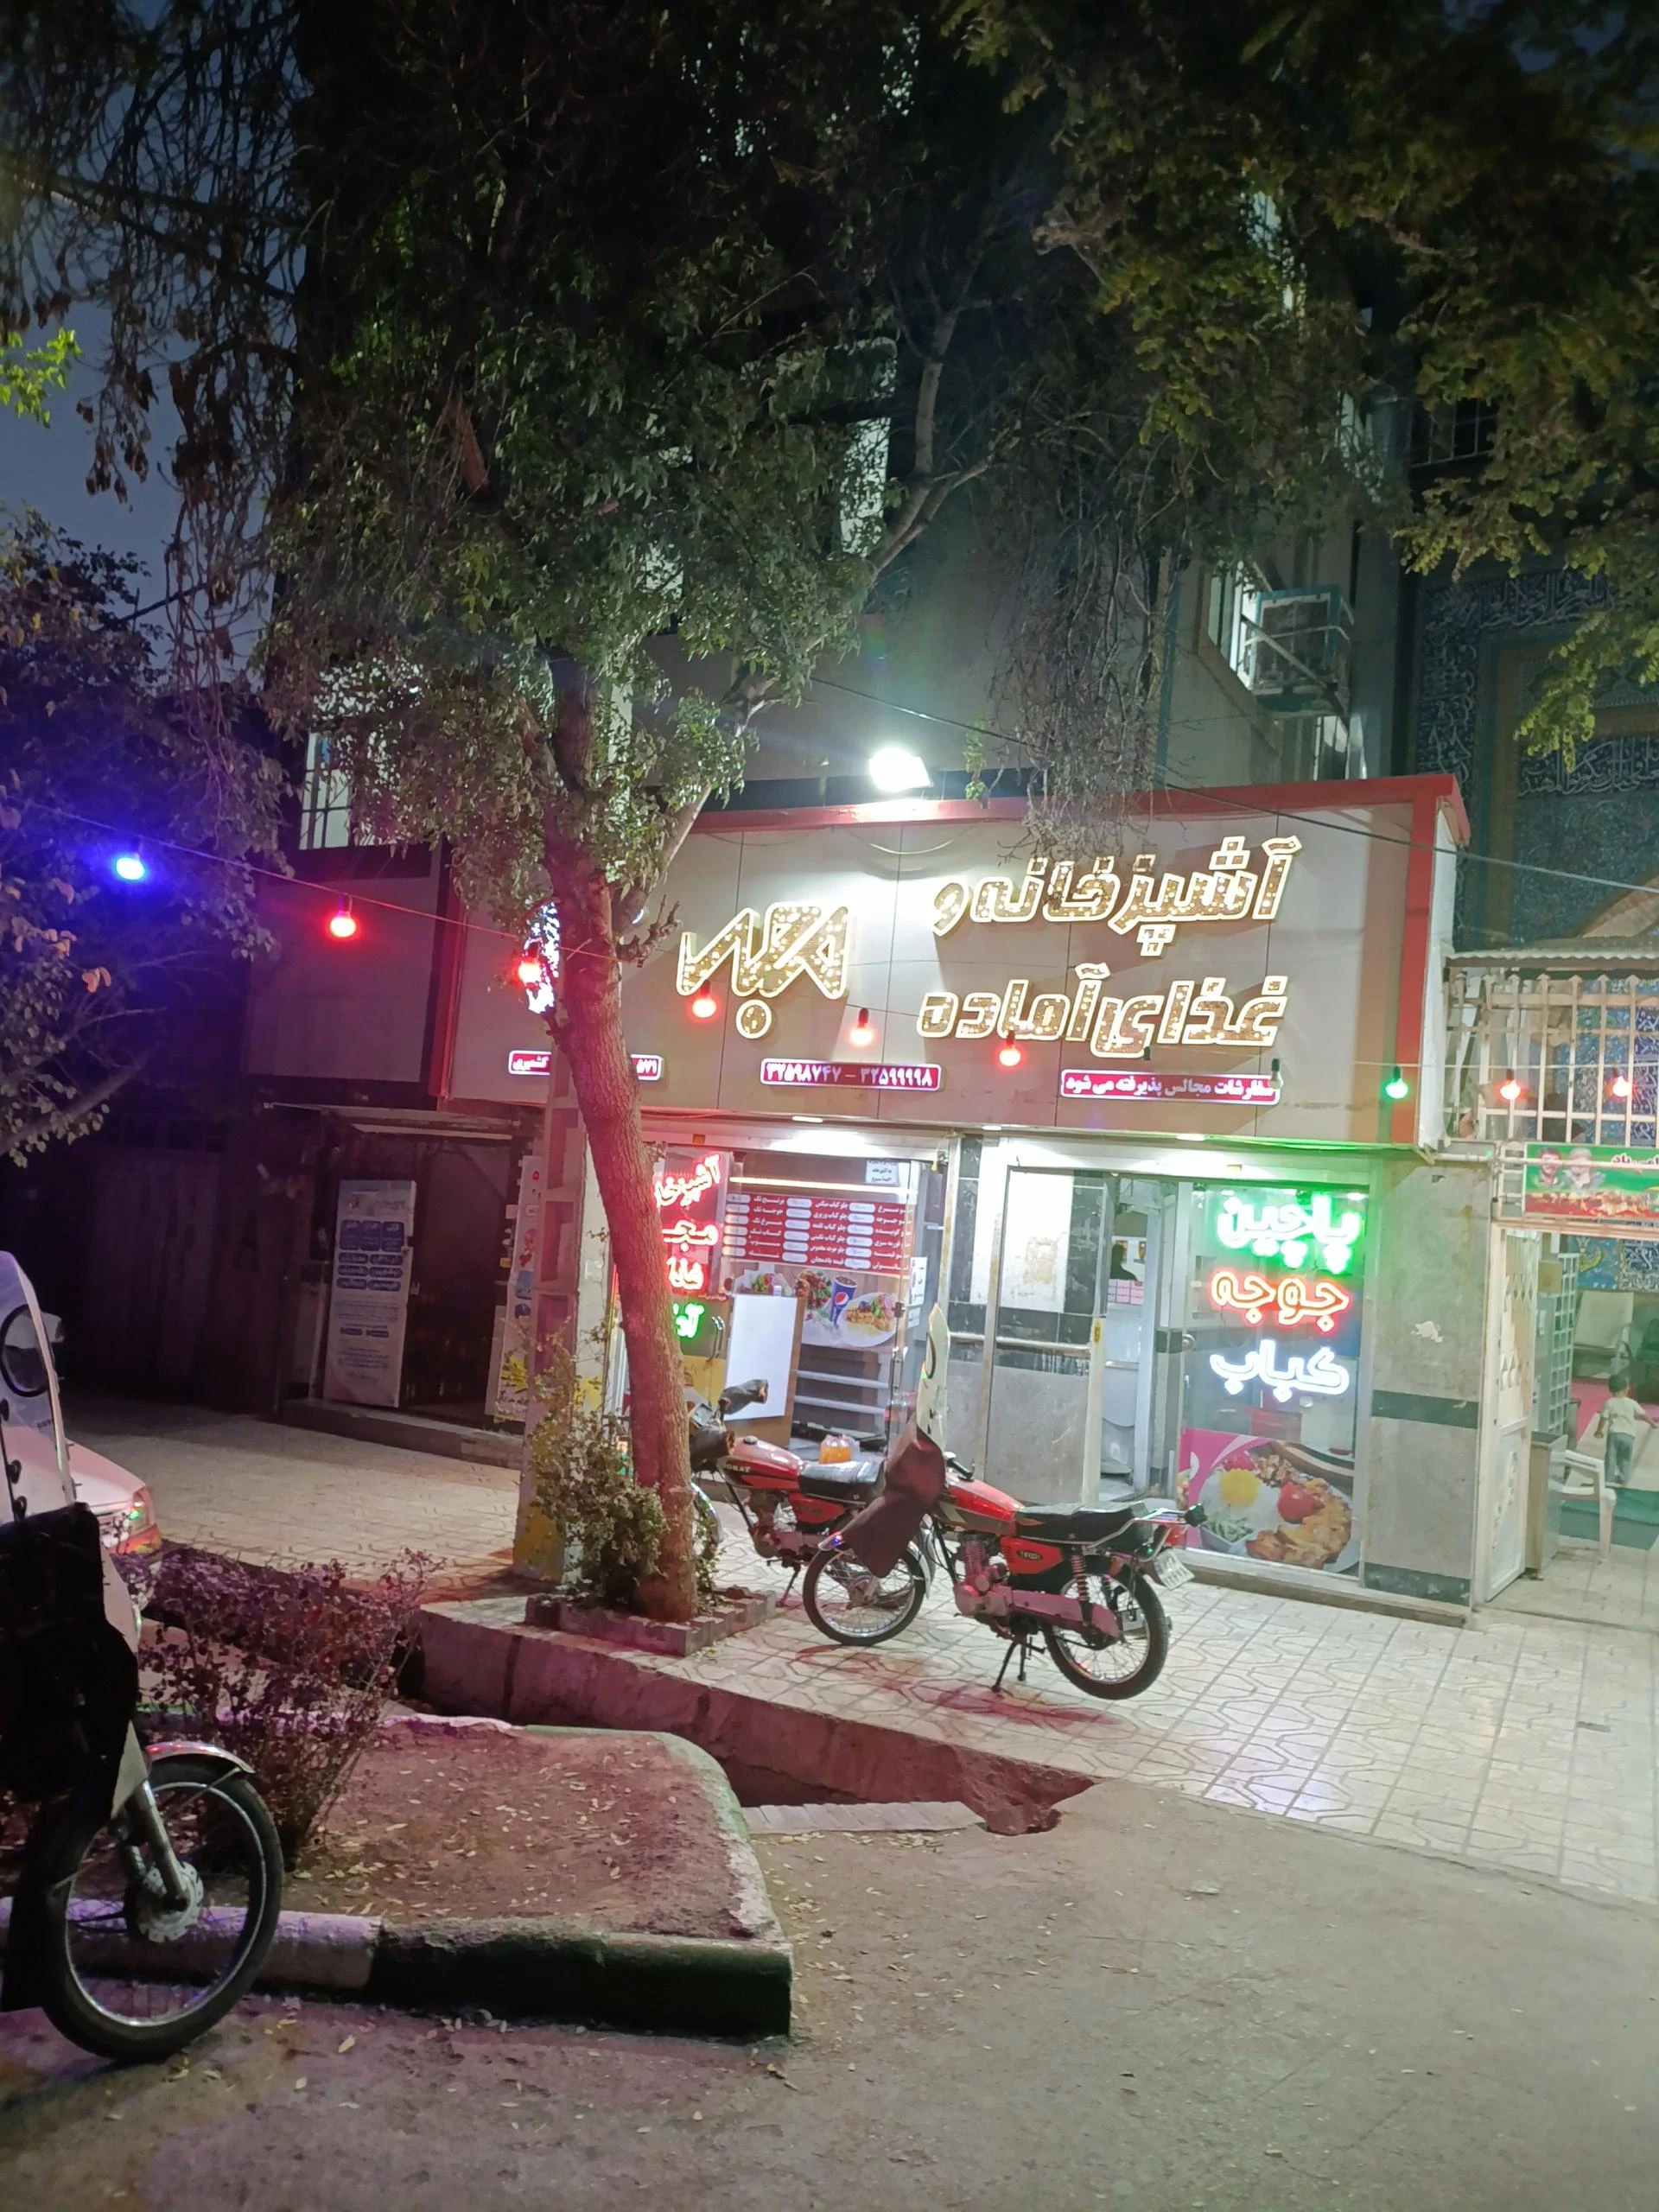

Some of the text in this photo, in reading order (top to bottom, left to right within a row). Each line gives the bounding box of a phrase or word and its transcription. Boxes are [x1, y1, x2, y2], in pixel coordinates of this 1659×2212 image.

[931, 836, 1301, 957] آشپزخانه و
[916, 963, 1288, 1058] غذای آماده
[860, 1067, 932, 1087] ۳۲۵۹۹۹۹۸
[1065, 1074, 1092, 1095] شود
[1164, 1077, 1211, 1097] مجالس
[1217, 1192, 1361, 1274] پاچین
[1210, 1271, 1351, 1332] جوجه
[1209, 1338, 1351, 1402] کباب
